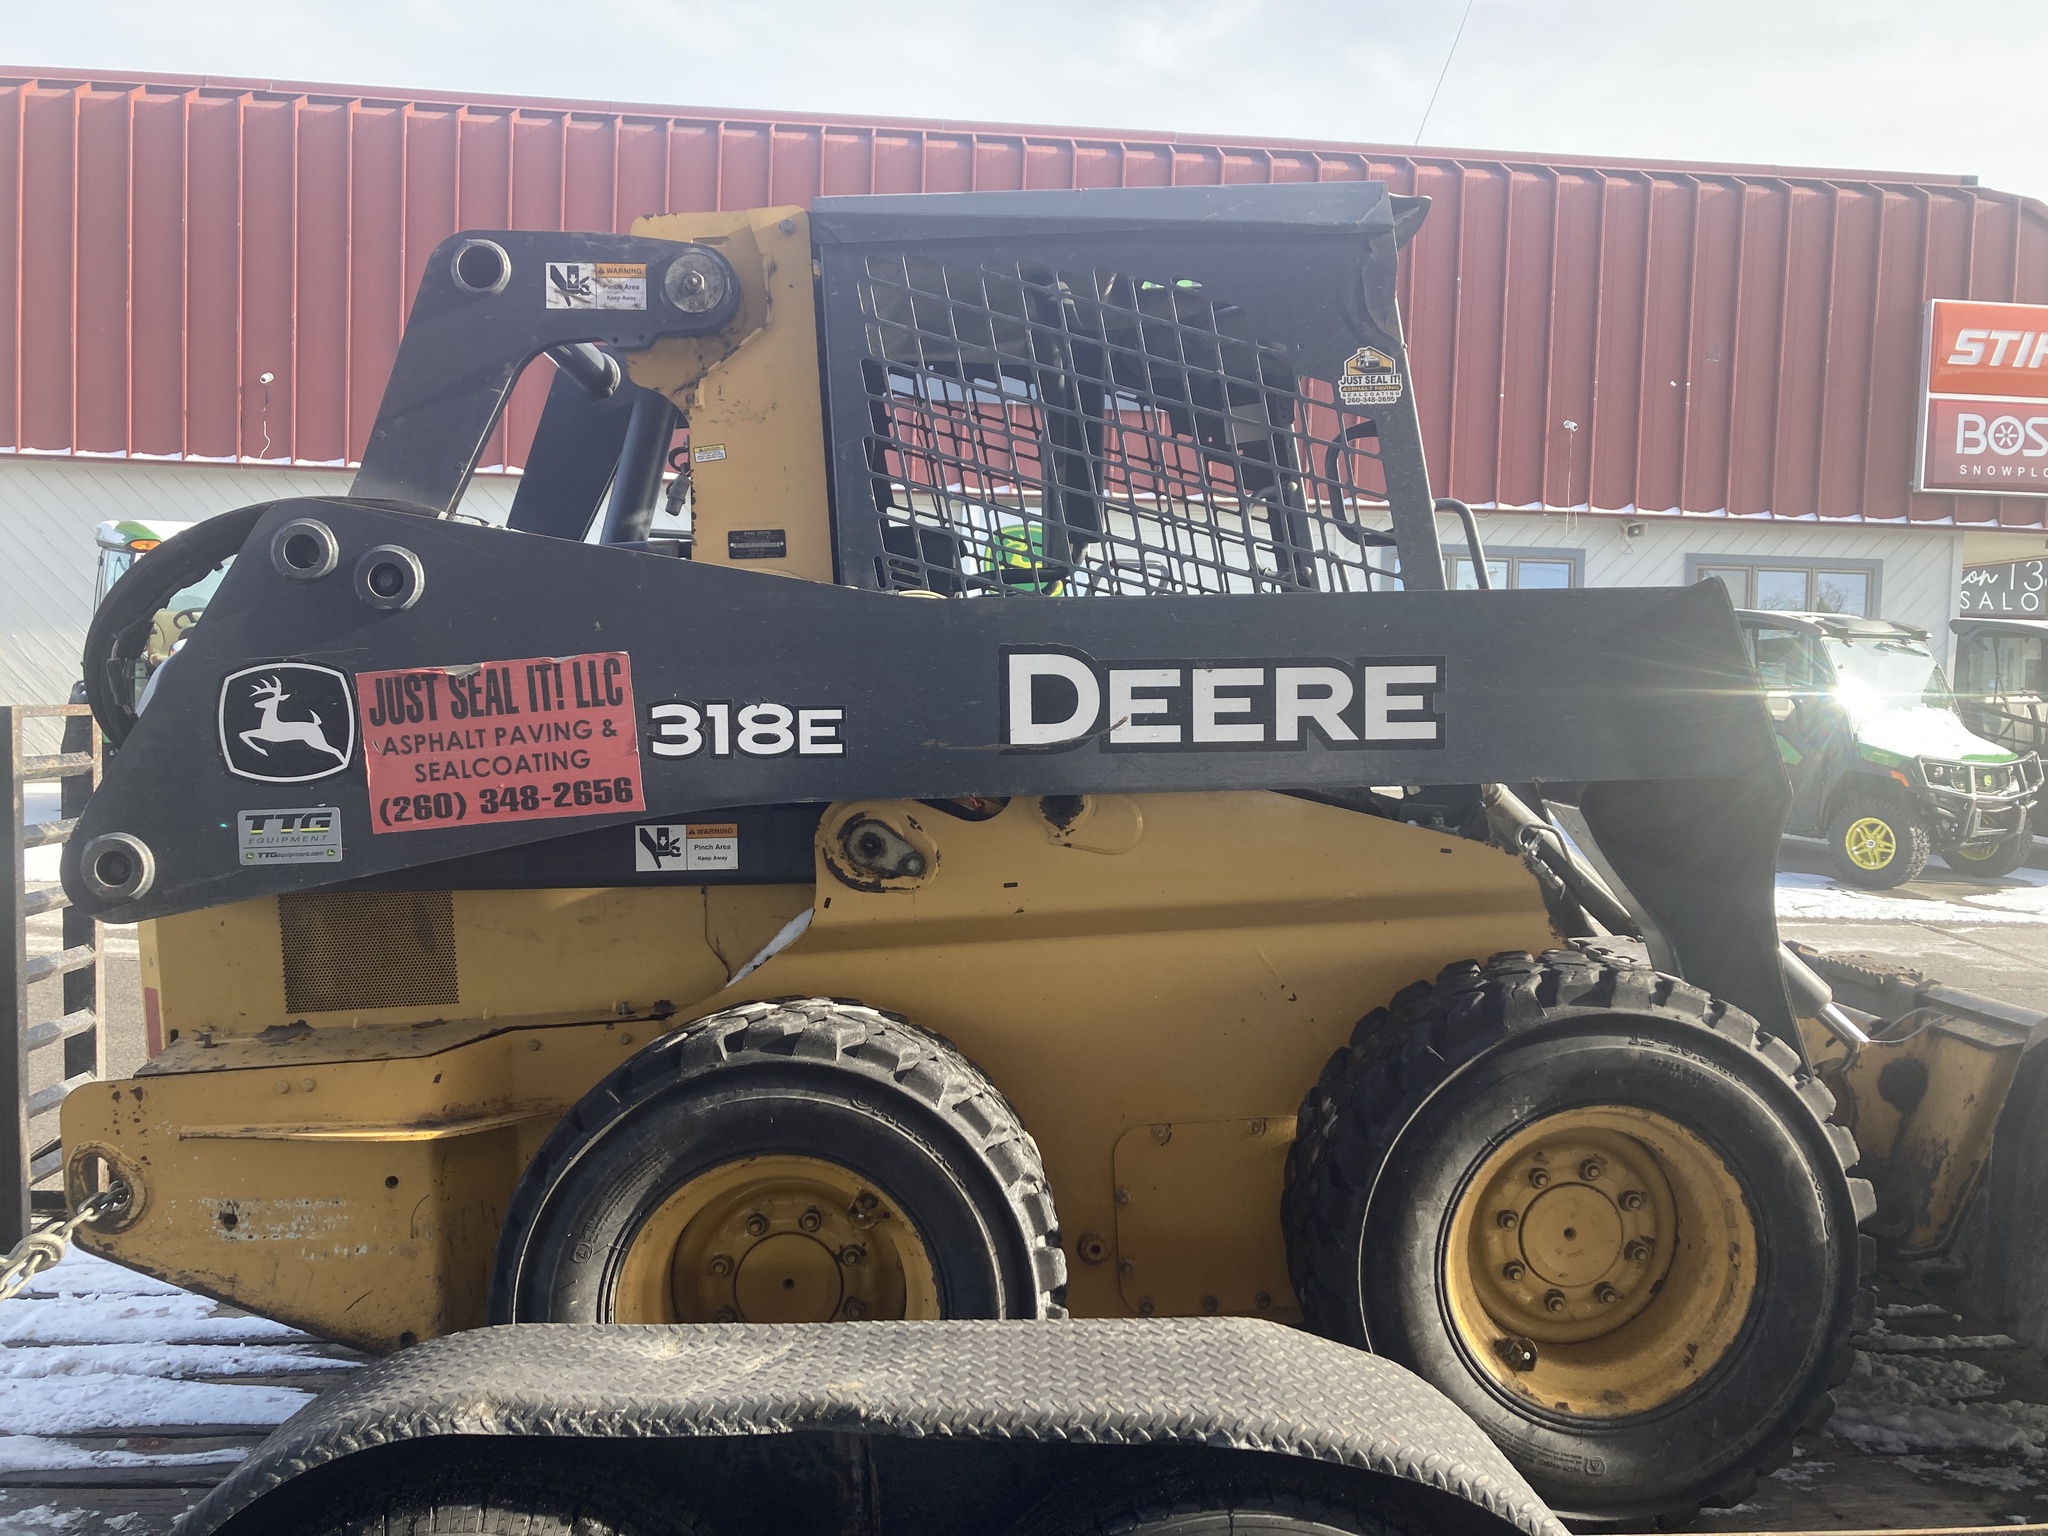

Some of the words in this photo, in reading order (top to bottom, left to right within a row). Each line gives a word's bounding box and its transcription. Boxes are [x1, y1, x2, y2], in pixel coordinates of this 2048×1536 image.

[1340, 376, 1363, 385] JUST
[1390, 375, 1400, 383] IT!
[369, 674, 438, 726] JUST
[448, 667, 519, 719] SEAL
[526, 663, 565, 712] IT!
[572, 658, 623, 708] LLC
[1009, 654, 1437, 744] DEERE
[382, 728, 486, 756] ASPHALT
[495, 719, 593, 747] PAVING
[602, 719, 617, 737] &
[652, 703, 842, 756] 318E
[415, 749, 591, 783] SEALCOATING
[380, 792, 467, 826] (260)
[479, 777, 633, 814] 348-2656
[245, 812, 332, 835] TTG
[248, 835, 328, 844] EQUIPMENT
